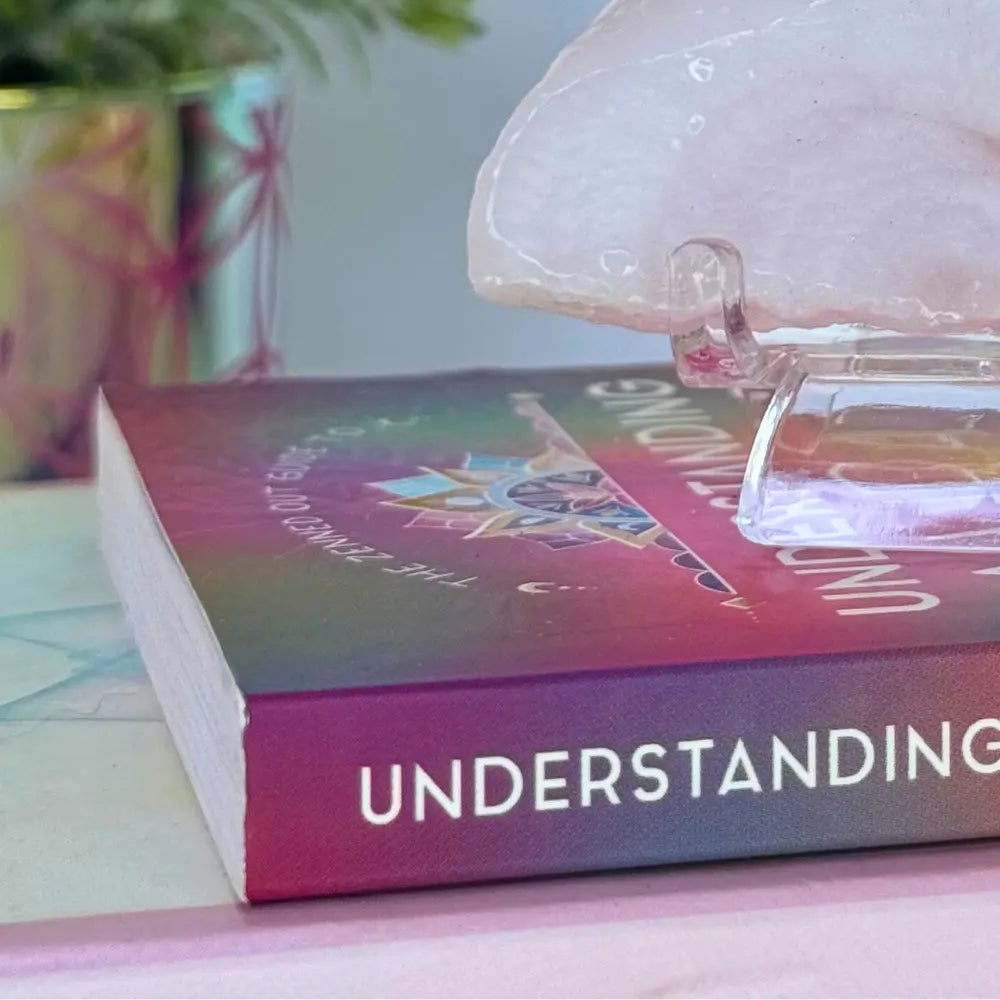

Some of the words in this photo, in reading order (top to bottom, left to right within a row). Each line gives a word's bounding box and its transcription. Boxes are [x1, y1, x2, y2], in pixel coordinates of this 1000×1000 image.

[264, 484, 311, 512] OUT
[281, 516, 395, 562] ZENNED
[381, 562, 478, 588] THE
